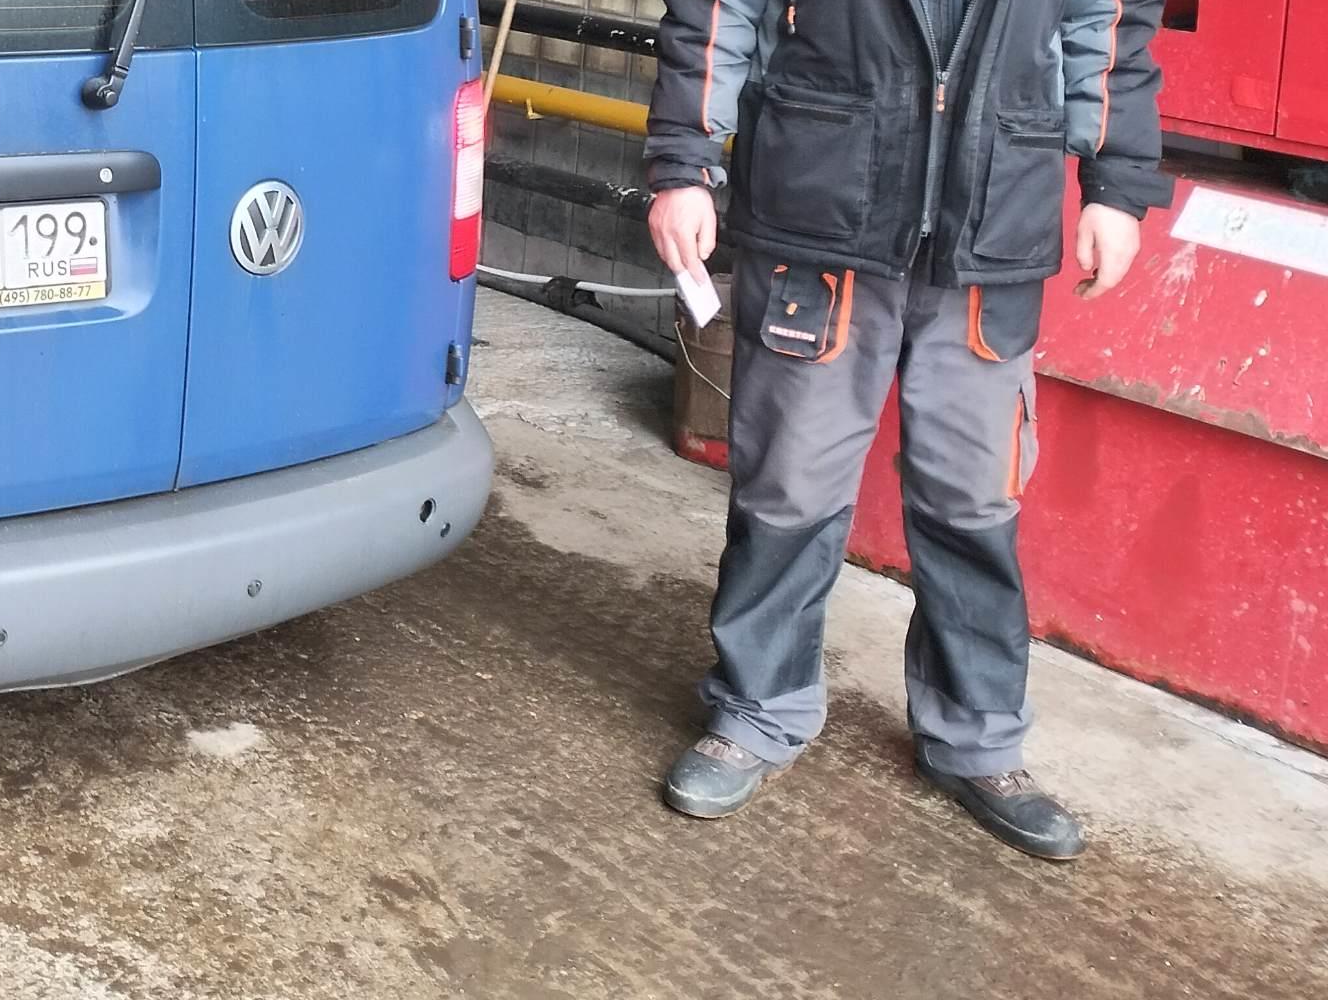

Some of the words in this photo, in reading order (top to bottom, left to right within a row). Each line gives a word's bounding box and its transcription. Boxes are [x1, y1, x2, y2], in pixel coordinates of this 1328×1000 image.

[10, 211, 87, 258] 199
[28, 260, 67, 278] RUS
[0, 289, 30, 306] (495)
[34, 284, 92, 302] 780-88-77
